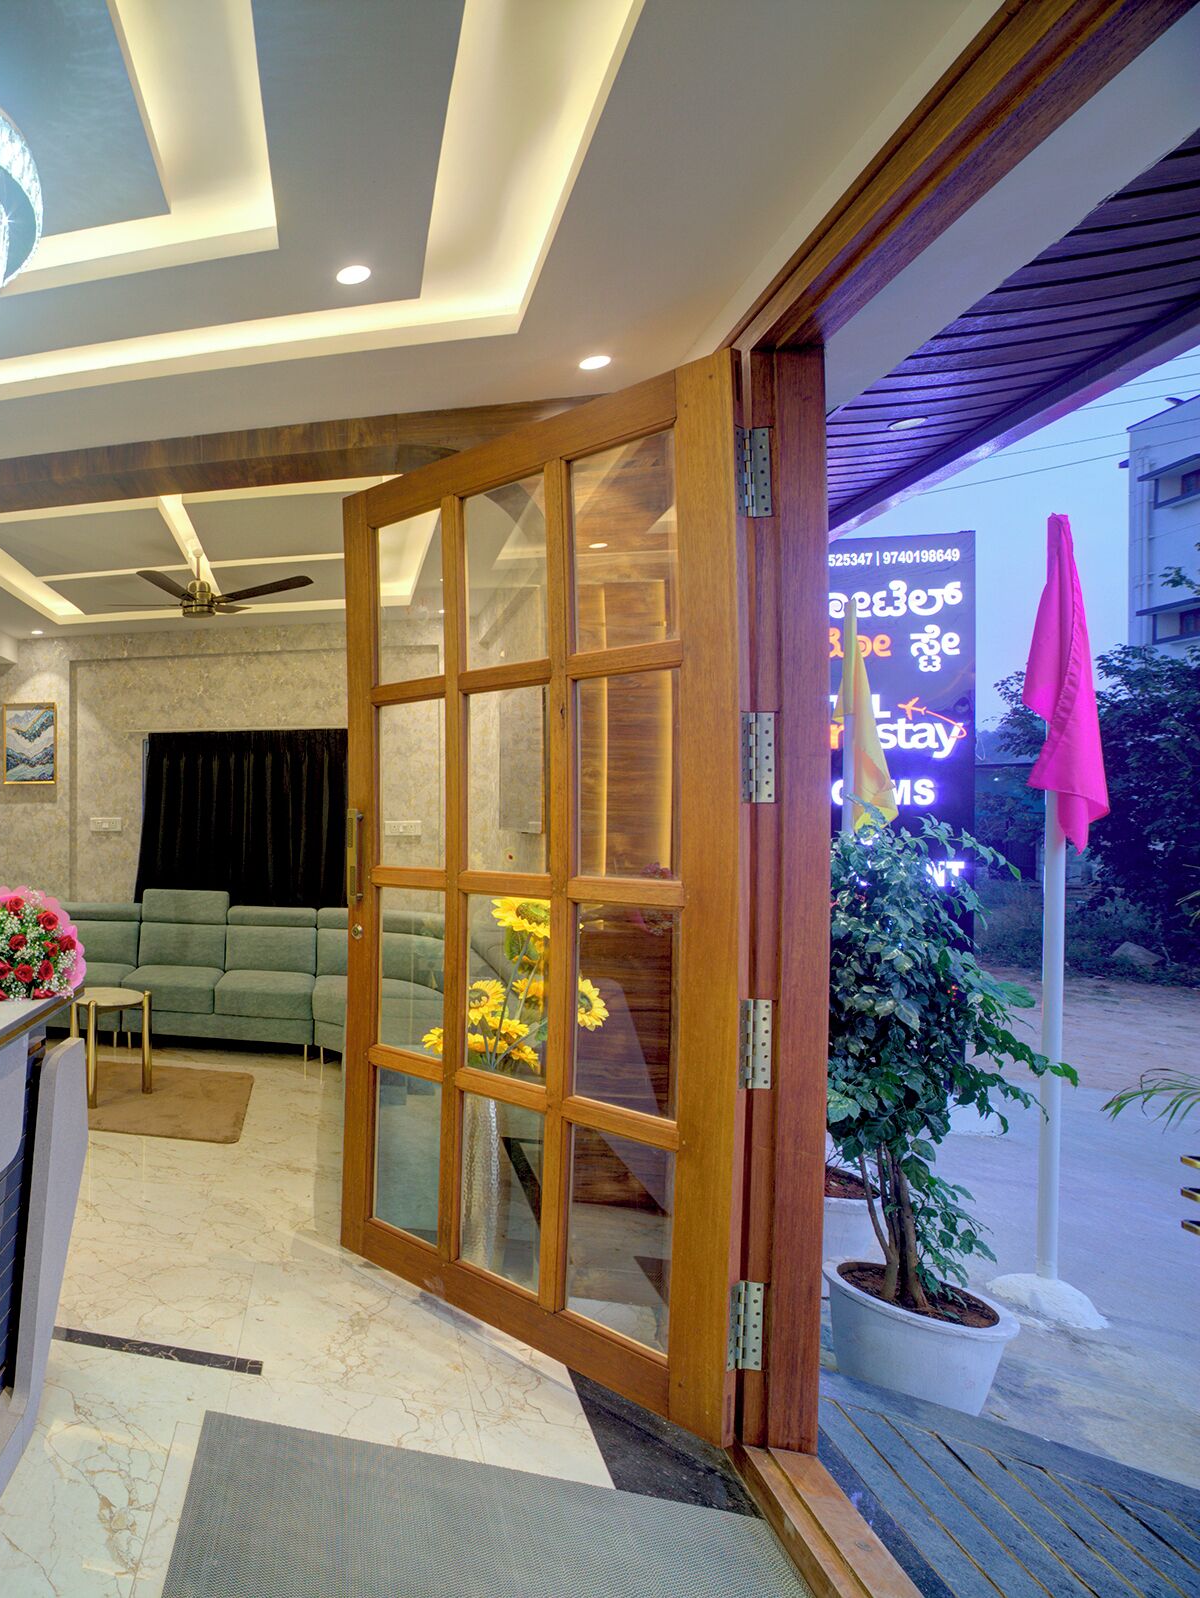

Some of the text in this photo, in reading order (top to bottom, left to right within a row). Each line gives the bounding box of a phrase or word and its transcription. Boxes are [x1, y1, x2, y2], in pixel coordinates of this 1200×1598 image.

[828, 553, 873, 567] 525347
[883, 548, 960, 565] 9740198649
[910, 624, 961, 672] ಸ್ಟೇ
[877, 718, 964, 758] stay
